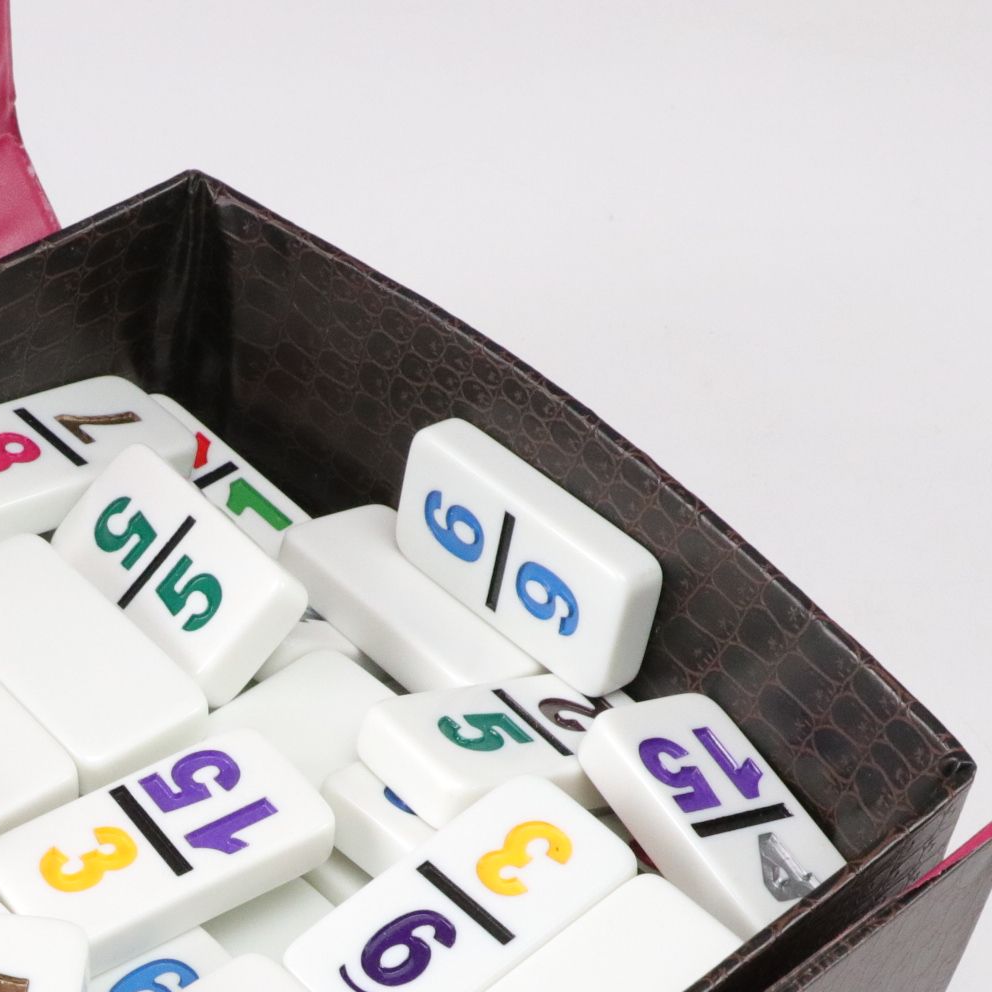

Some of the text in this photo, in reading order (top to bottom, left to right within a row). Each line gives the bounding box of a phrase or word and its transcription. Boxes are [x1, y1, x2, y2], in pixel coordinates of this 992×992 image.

[95, 497, 159, 571] 5
[156, 554, 223, 632] 5
[438, 712, 534, 752] 5
[639, 726, 765, 813] 15
[138, 749, 279, 855] 15
[39, 826, 139, 894] 3
[476, 820, 574, 897] 3
